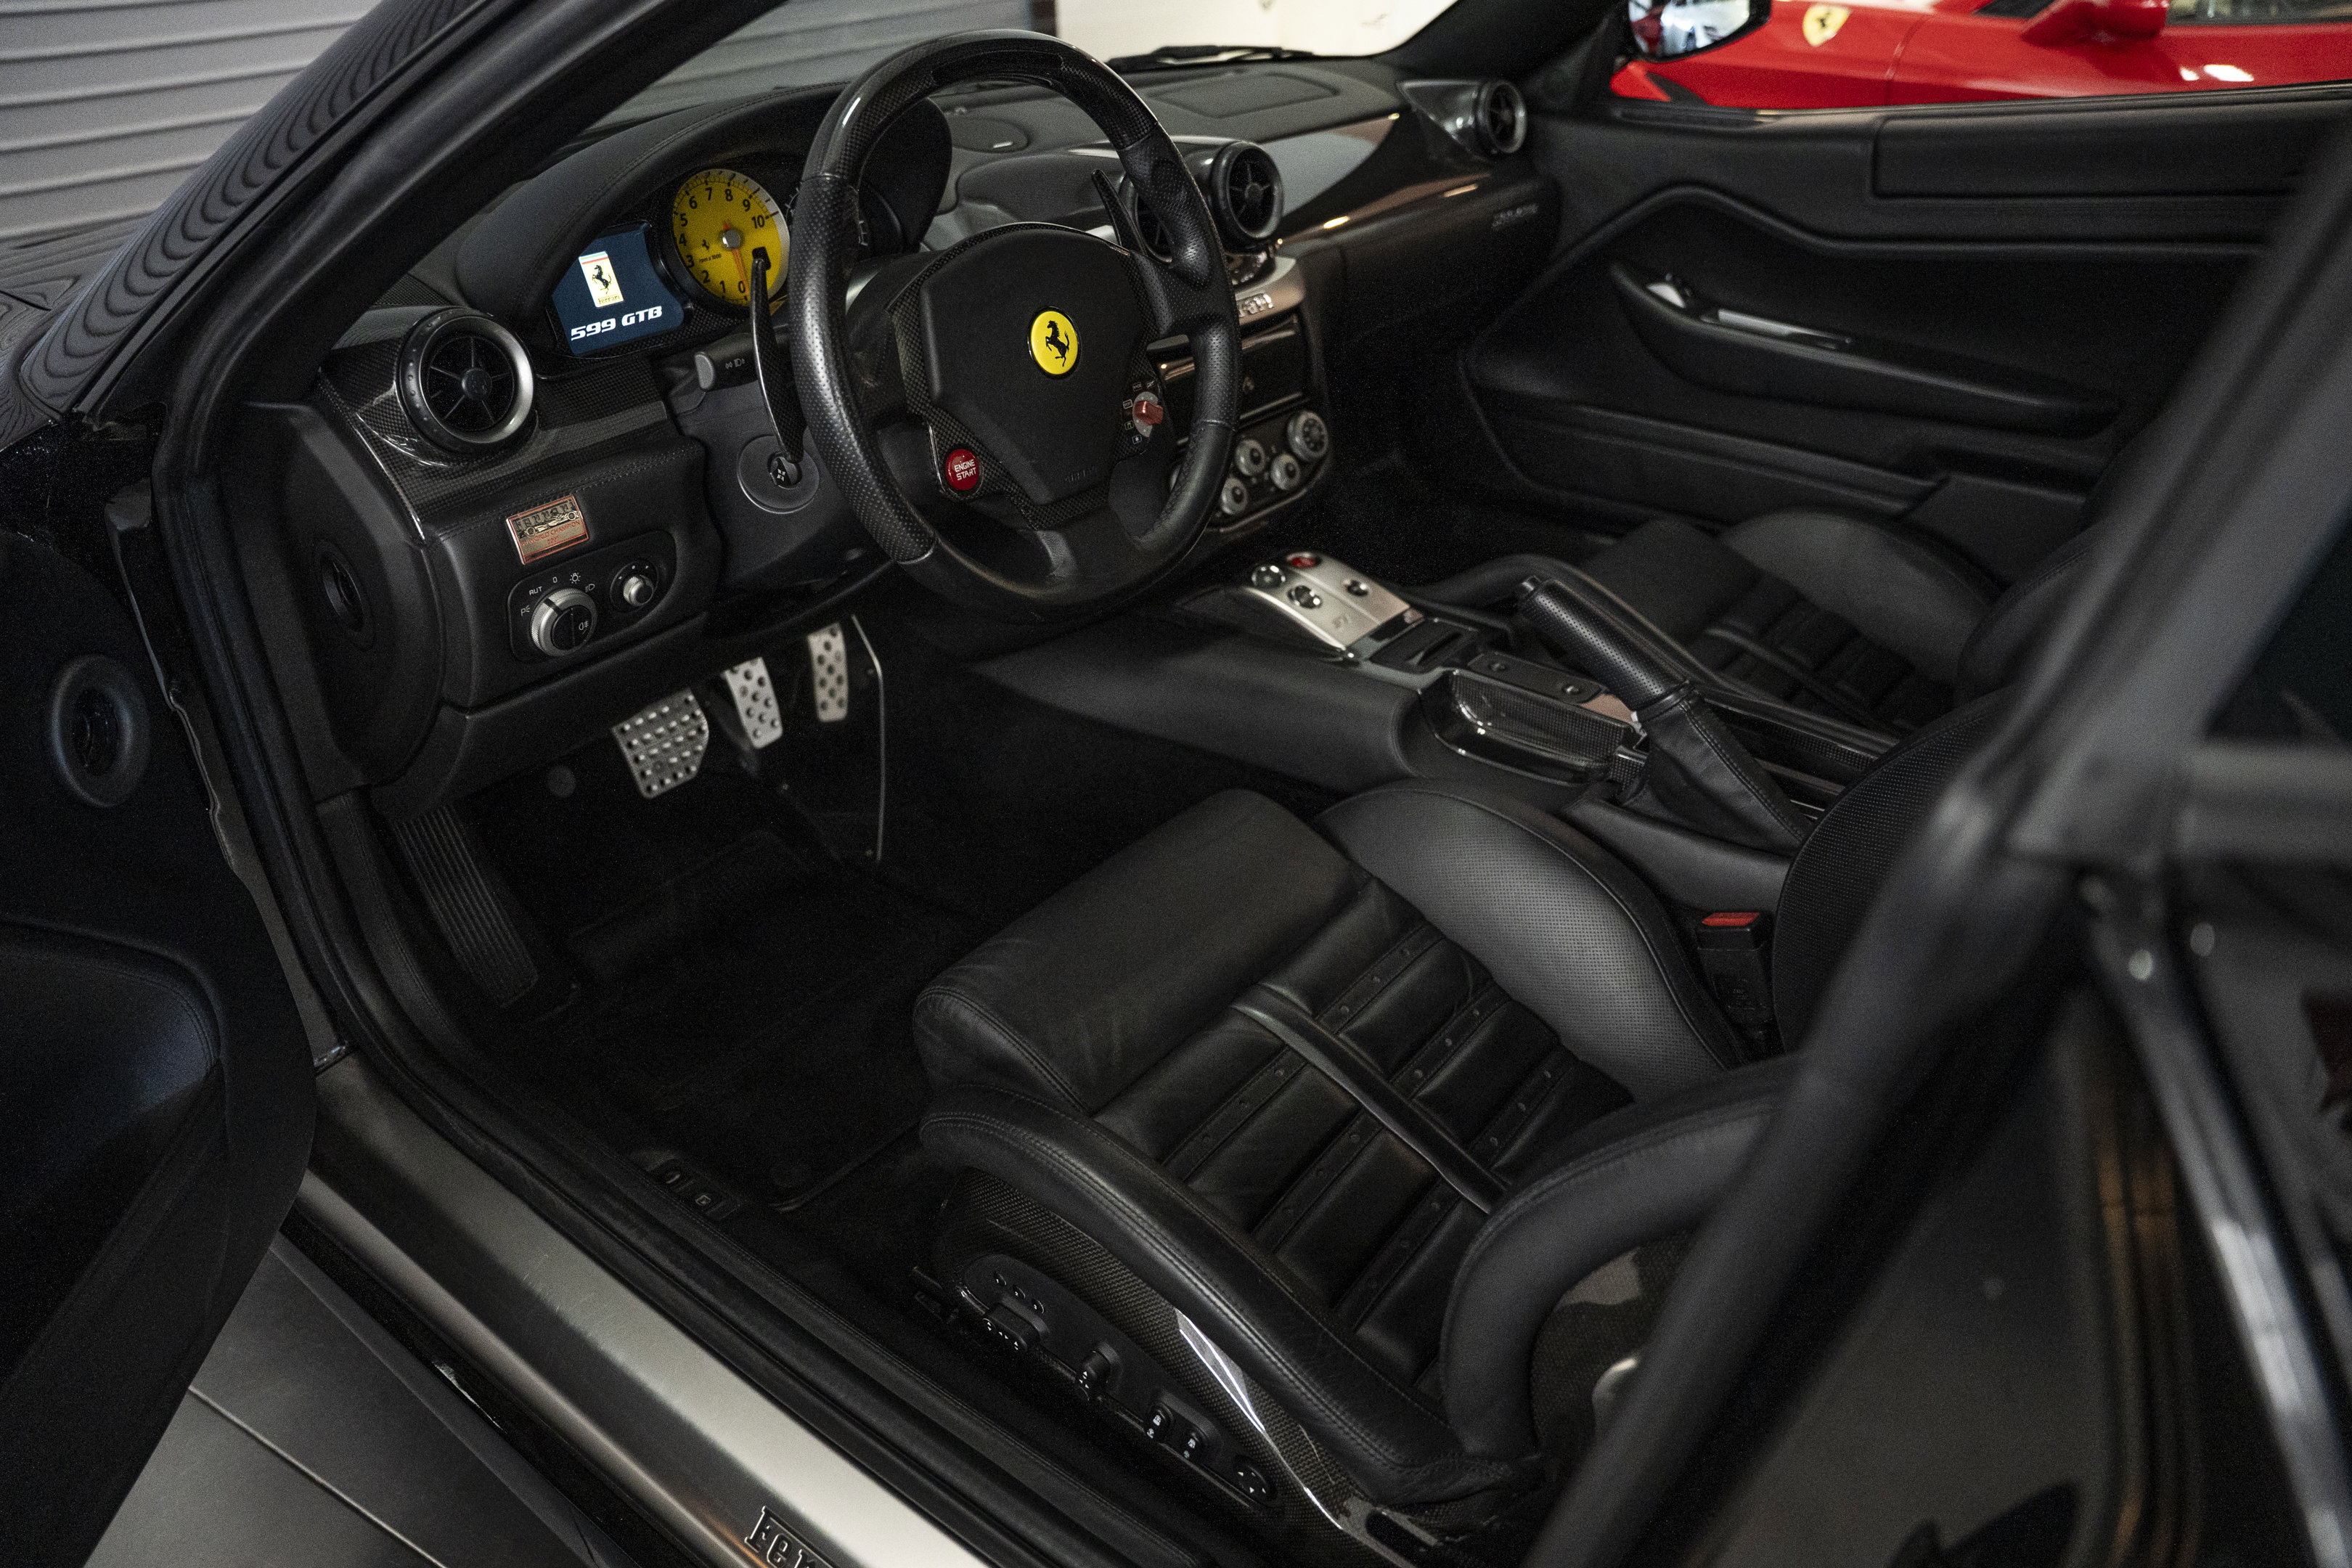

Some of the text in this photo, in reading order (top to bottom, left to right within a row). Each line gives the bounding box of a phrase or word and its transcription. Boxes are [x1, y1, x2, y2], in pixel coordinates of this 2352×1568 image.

[706, 187, 712, 200] 7
[725, 189, 733, 202] 8
[689, 196, 698, 209] 6
[743, 199, 751, 212] 9
[680, 213, 688, 226] 5
[752, 215, 765, 229] 10
[679, 233, 687, 246] 4
[686, 255, 695, 268] 3
[701, 270, 711, 284] 2
[719, 280, 726, 293] 1
[738, 280, 746, 293] 0
[597, 294, 621, 304] Ferrari
[571, 306, 662, 341] 599 GTB
[955, 459, 975, 473] ENGINE
[956, 467, 976, 481] START
[529, 531, 550, 544] WORLD
[551, 520, 581, 536] CHAMPION
